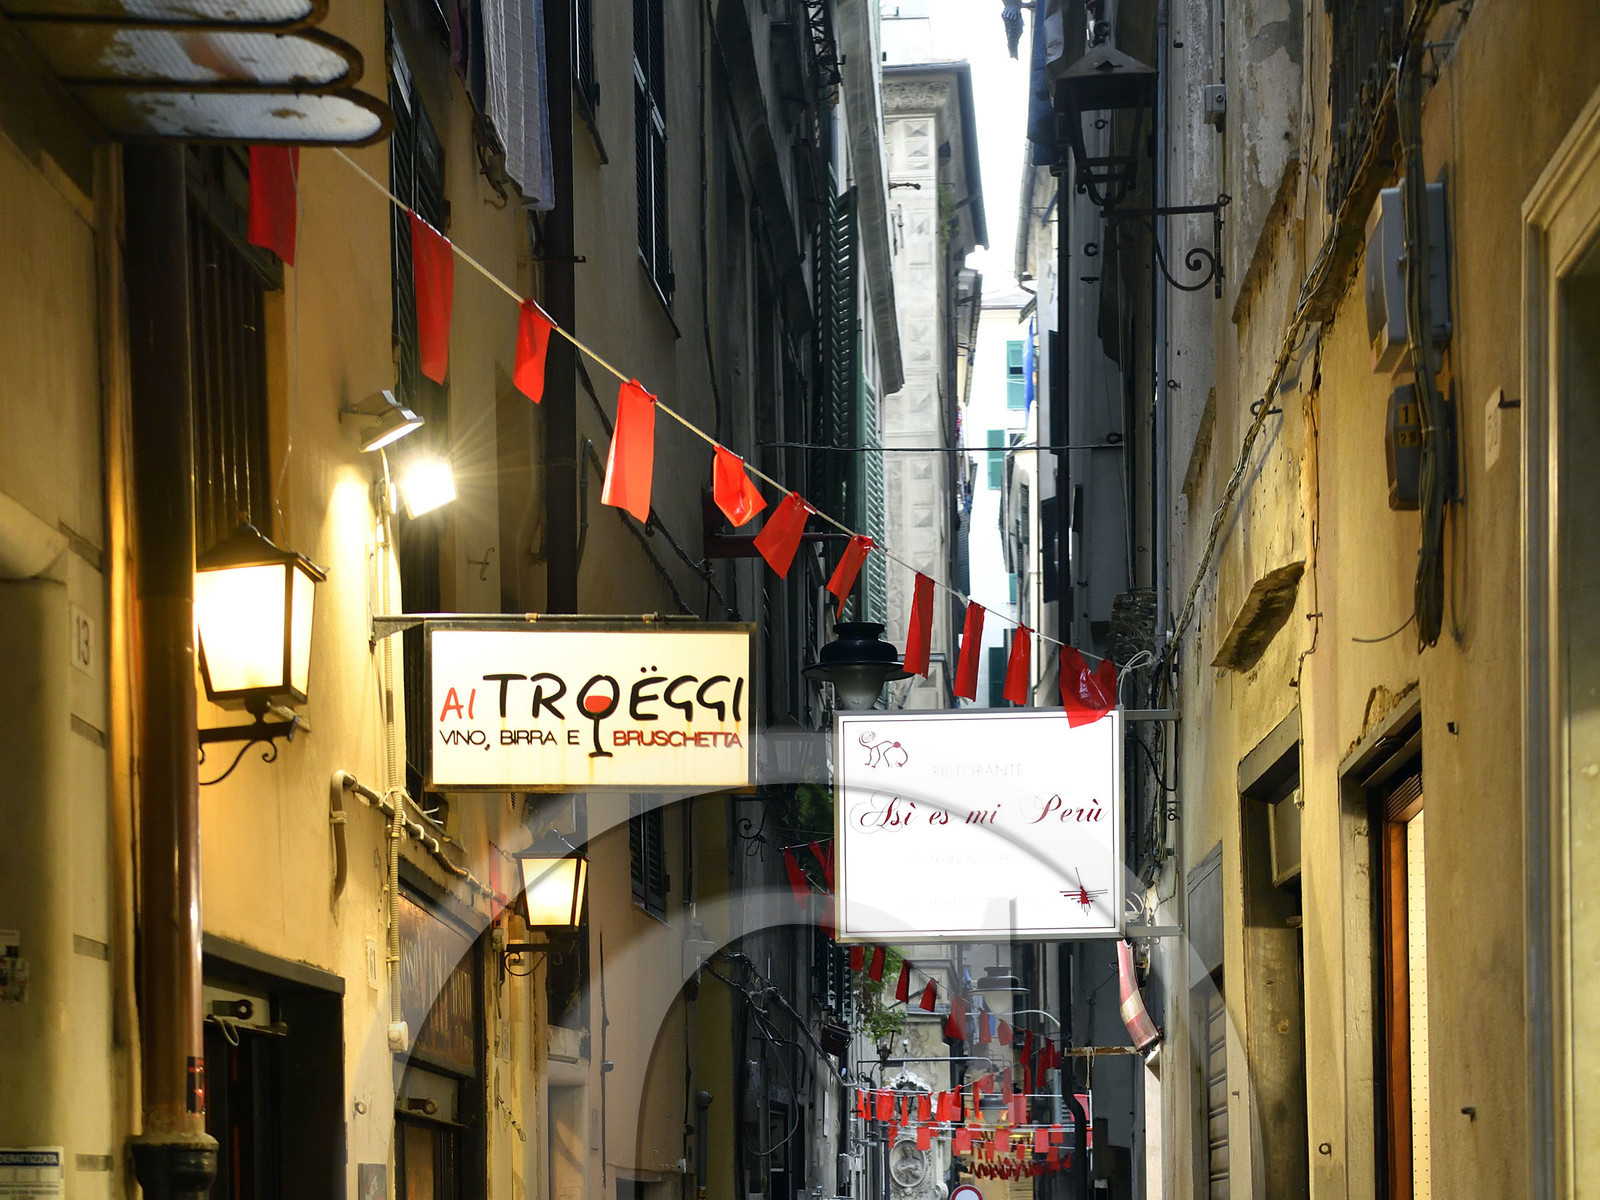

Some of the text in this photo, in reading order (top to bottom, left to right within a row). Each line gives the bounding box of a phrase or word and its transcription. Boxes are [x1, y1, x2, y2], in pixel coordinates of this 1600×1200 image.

[76, 613, 91, 667] 13
[439, 730, 743, 751] VINO, BIRRA E BRUSCHETTA
[932, 764, 1024, 778] RISTORANTE
[928, 807, 953, 826] es
[964, 803, 1003, 826] mi
